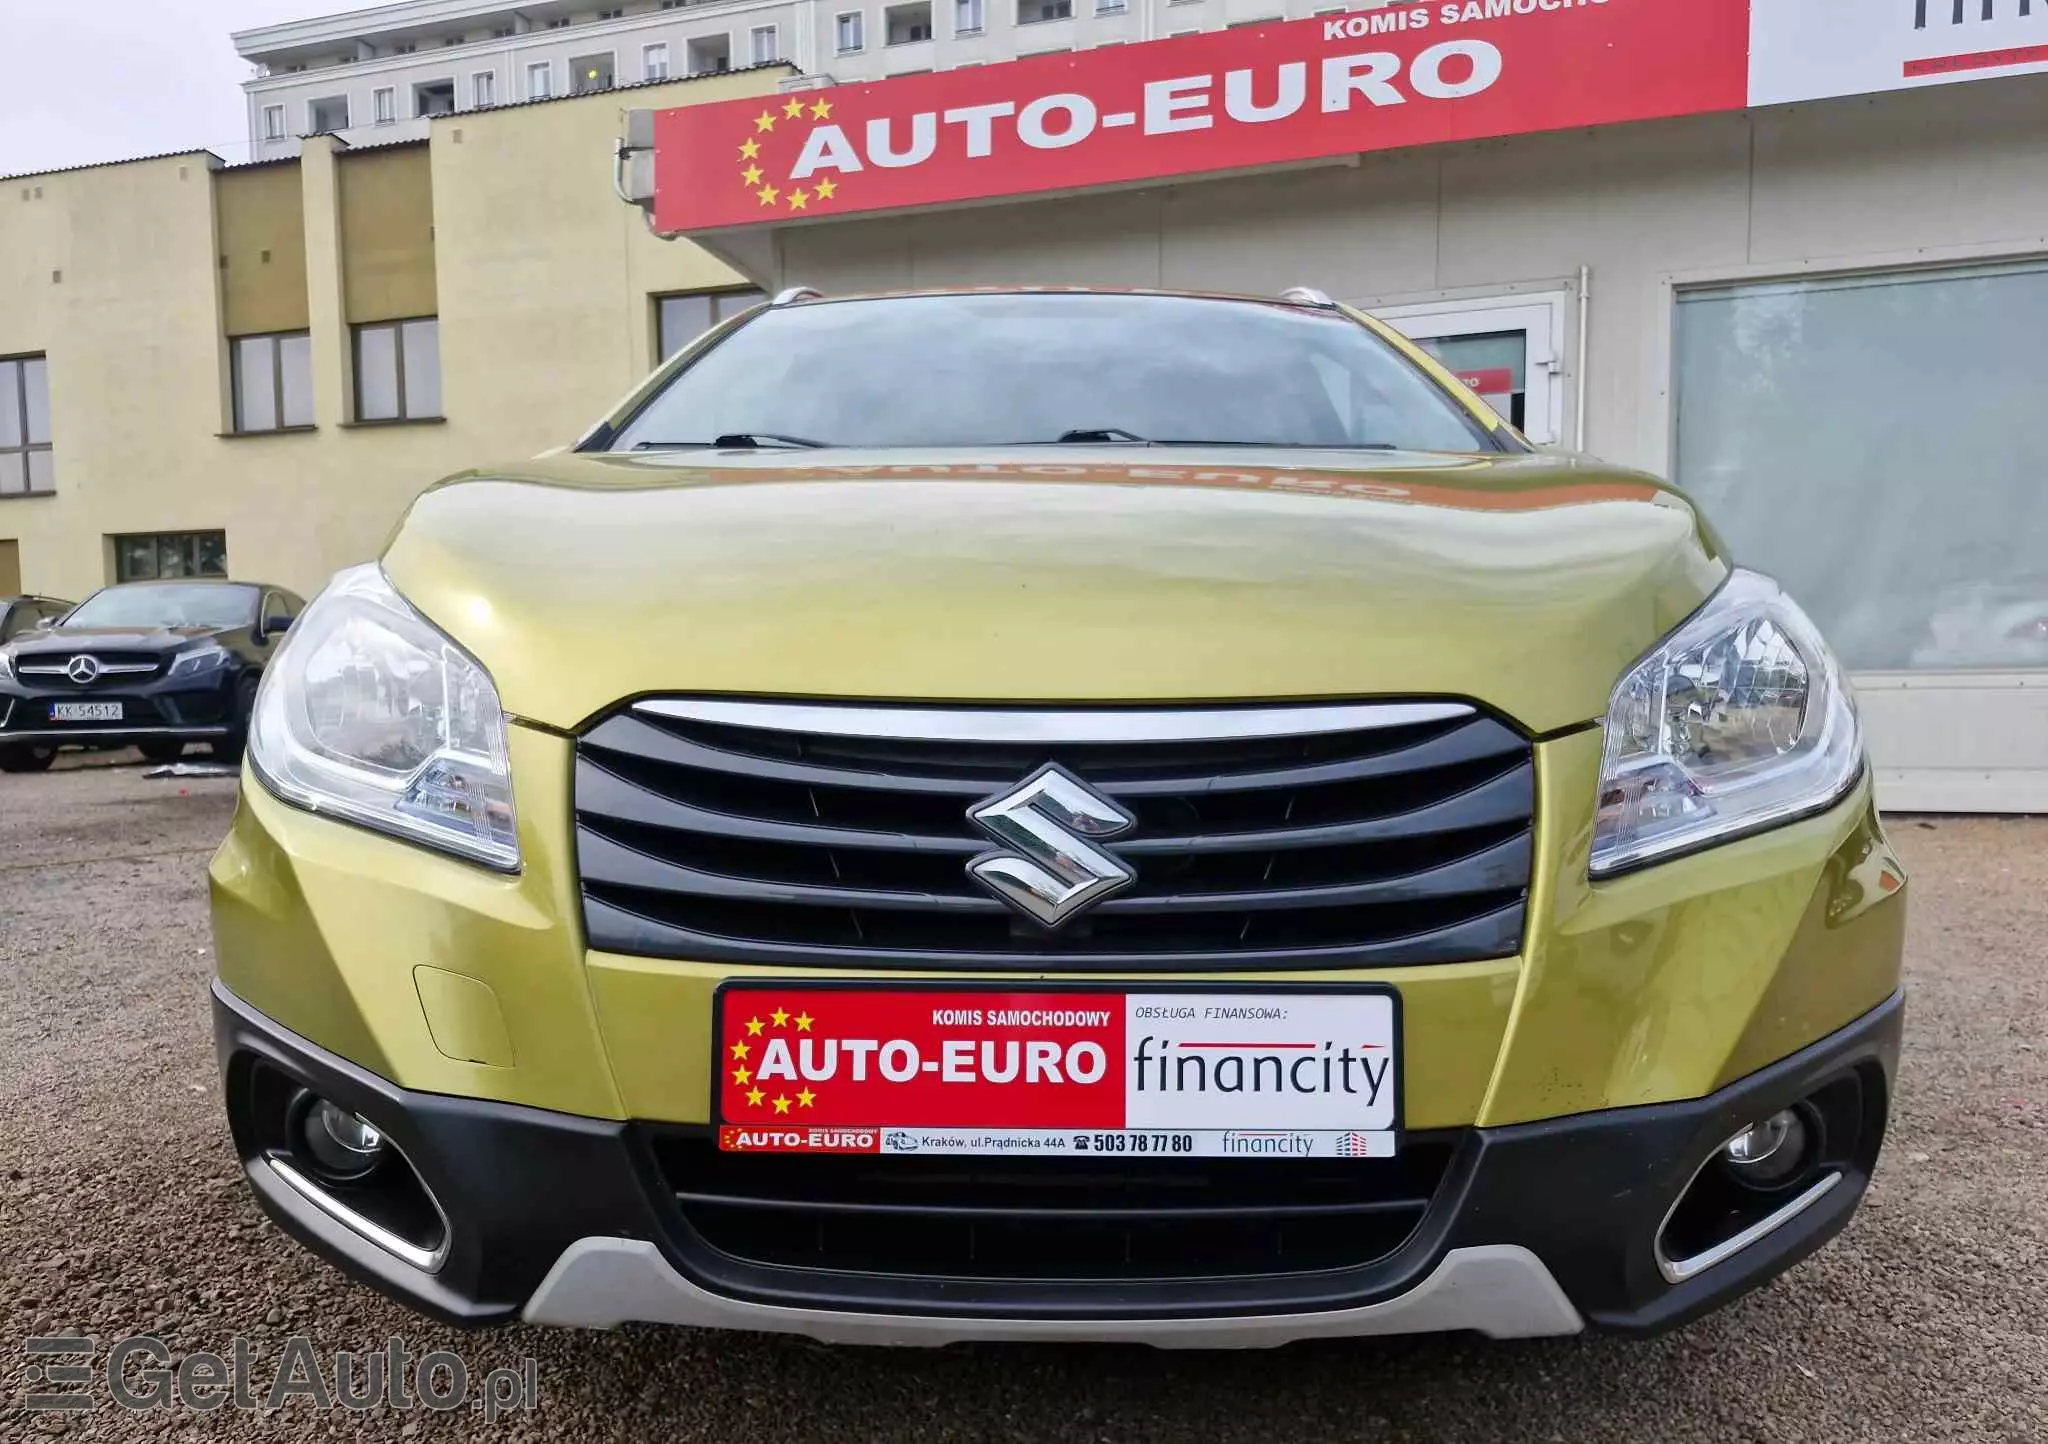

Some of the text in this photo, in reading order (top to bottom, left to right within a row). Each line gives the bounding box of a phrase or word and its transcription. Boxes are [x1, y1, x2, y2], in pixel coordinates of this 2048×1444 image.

[1323, 0, 1608, 40] KOMIS SAMOC
[789, 39, 1502, 179] AUTO-EURO
[57, 704, 119, 717] KK 54512
[932, 1010, 1111, 1027] KOMIS SAMOCHODOWY
[1135, 1007, 1288, 1020] OBSŁUGA FINANSOWA:
[756, 1038, 1107, 1084] AUTO-EURO
[1133, 1035, 1390, 1107] financity
[736, 1132, 873, 1148] AUTO-EURO
[922, 1136, 1066, 1150] Kraków, ul.Prądnicka 44A
[1094, 1134, 1193, 1152] 503 78 77 80
[1222, 1131, 1314, 1157] financity
